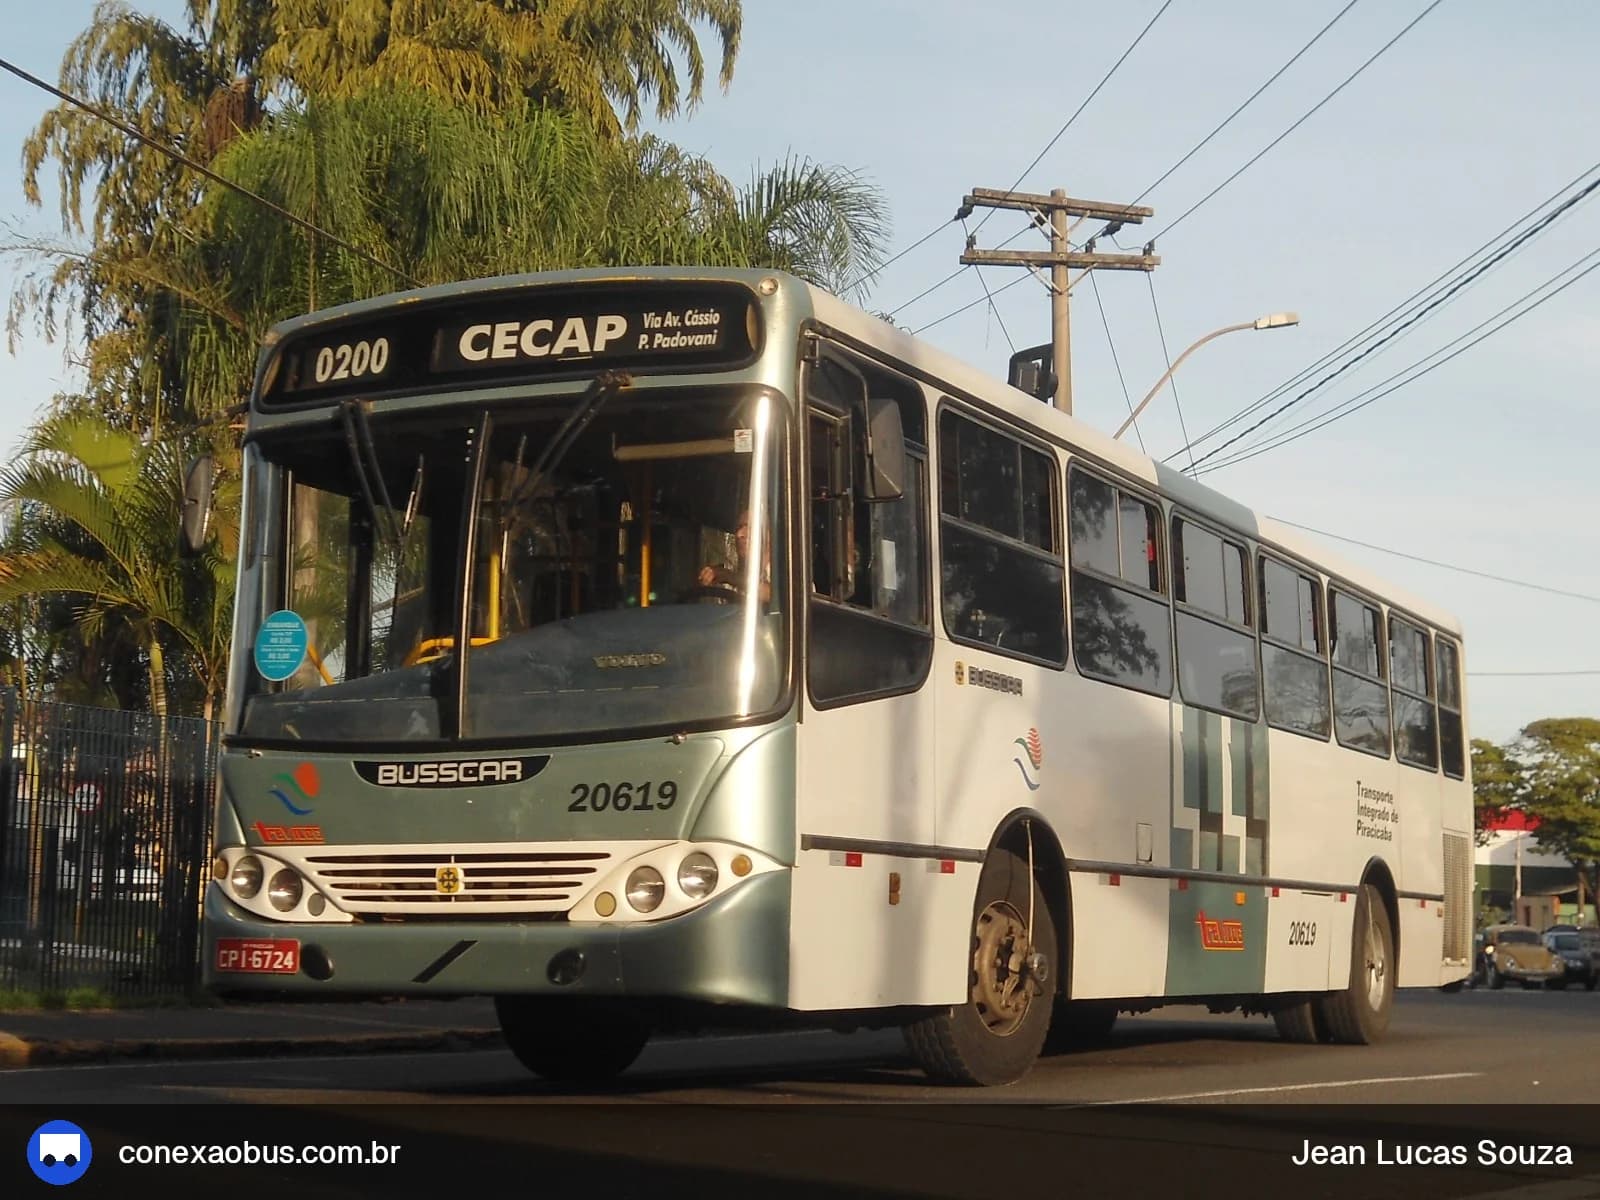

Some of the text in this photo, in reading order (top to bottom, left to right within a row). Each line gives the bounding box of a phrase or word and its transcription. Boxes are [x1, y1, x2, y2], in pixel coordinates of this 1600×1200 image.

[643, 308, 720, 329] Via Av. Cássio
[458, 314, 628, 361] CECAP
[638, 330, 718, 349] P. Padovani
[315, 337, 389, 383] 0200
[377, 760, 523, 785] BUSSCAR
[568, 781, 678, 812] 20619
[1356, 780, 1393, 805] Transporte
[1357, 799, 1398, 823] Integrado de
[1356, 819, 1392, 841] Piracicaba
[1289, 920, 1317, 946] 20619
